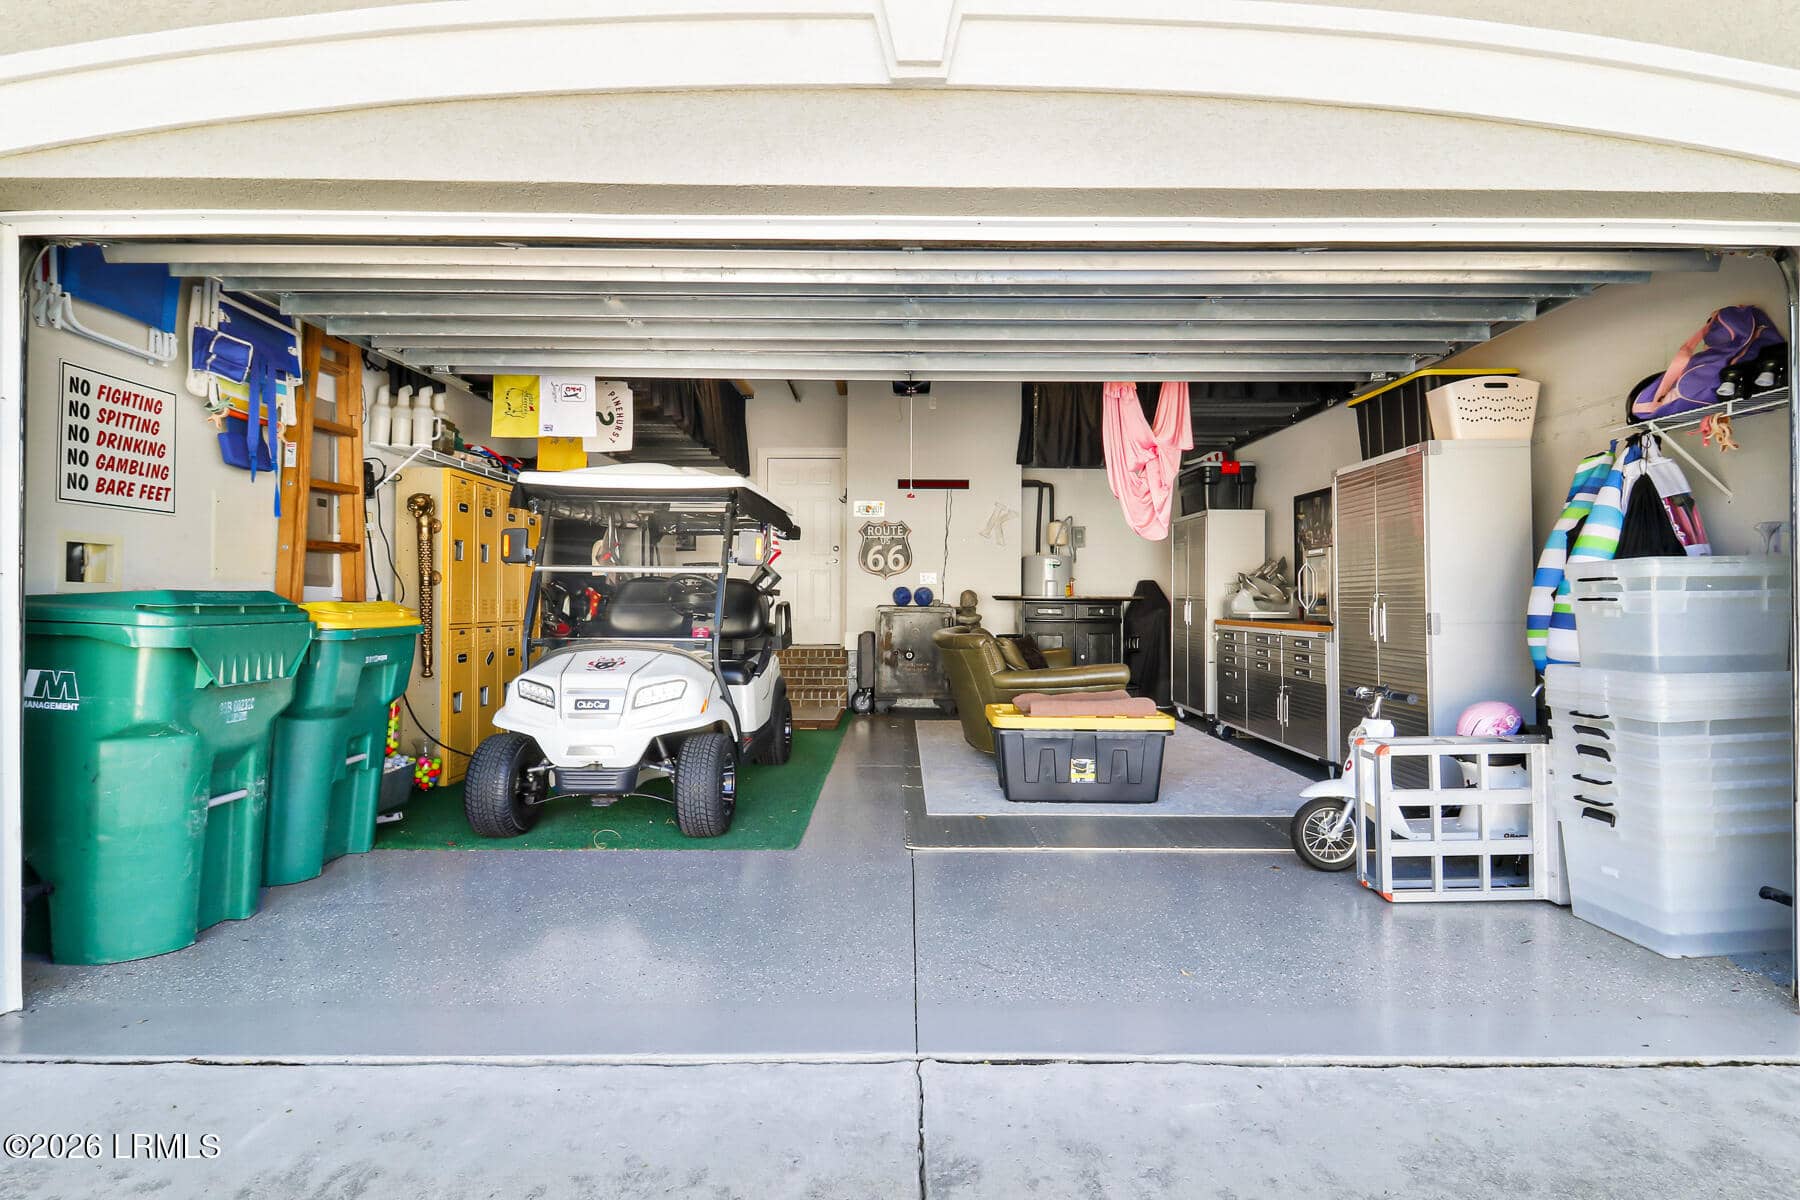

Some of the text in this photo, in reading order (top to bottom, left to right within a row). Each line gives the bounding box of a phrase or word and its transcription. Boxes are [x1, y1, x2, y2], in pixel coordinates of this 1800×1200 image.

[69, 376, 163, 415] NO FIGHTING
[68, 400, 161, 435] NO SPITTING
[68, 424, 166, 459] NO DRINKING
[67, 448, 170, 480] NO GAMBLING
[66, 472, 172, 502] NO BARE FEET
[867, 525, 904, 535] ROUTE
[867, 544, 905, 571] 66
